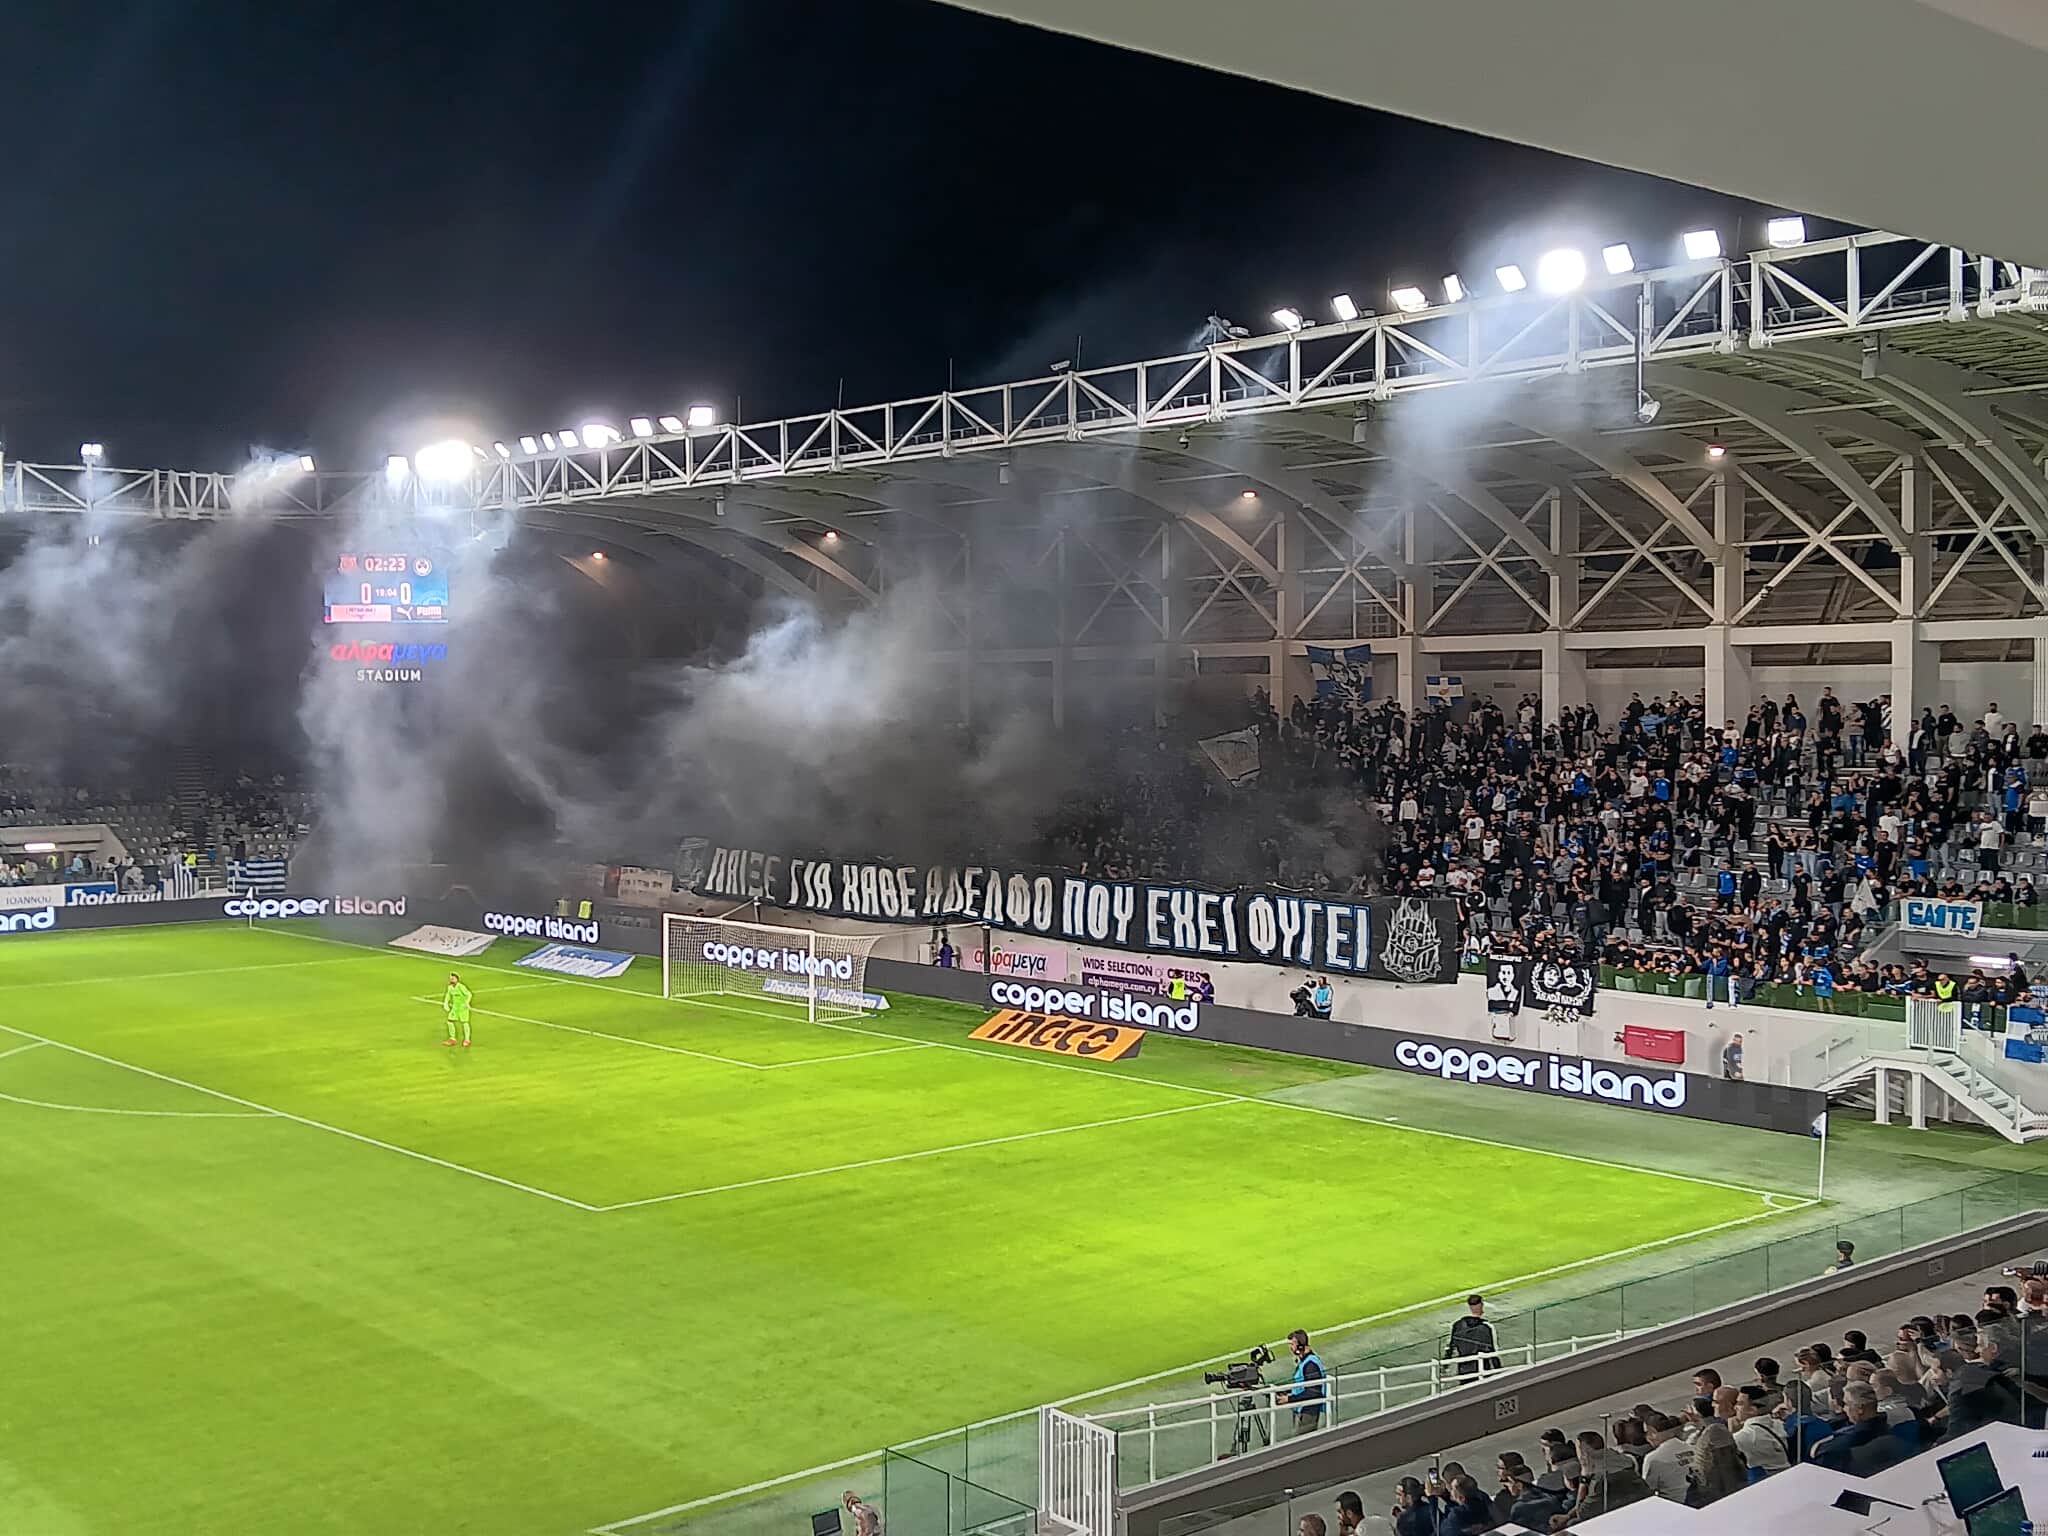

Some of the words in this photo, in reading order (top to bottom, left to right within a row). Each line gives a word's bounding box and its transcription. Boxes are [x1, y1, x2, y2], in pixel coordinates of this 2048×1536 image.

[365, 557, 406, 572] 02:23
[361, 583, 372, 604] 0
[400, 583, 411, 605] 0
[356, 669, 421, 681] STADIUM
[224, 899, 329, 918] copper
[334, 896, 406, 915] island
[1063, 878, 1135, 944] ΠΟΥ
[1147, 889, 1238, 953] ΕΧΕΙ
[484, 912, 543, 935] copper
[544, 916, 600, 943] island
[703, 941, 778, 970] copper
[782, 948, 853, 980] island
[974, 947, 1047, 976] αφαμεγα
[1082, 956, 1105, 971] WIDE
[1107, 960, 1153, 977] SELECTION
[991, 981, 1097, 1016] copper
[1100, 989, 1199, 1033] island
[1395, 1040, 1541, 1084] copper
[1549, 1056, 1687, 1108] island
